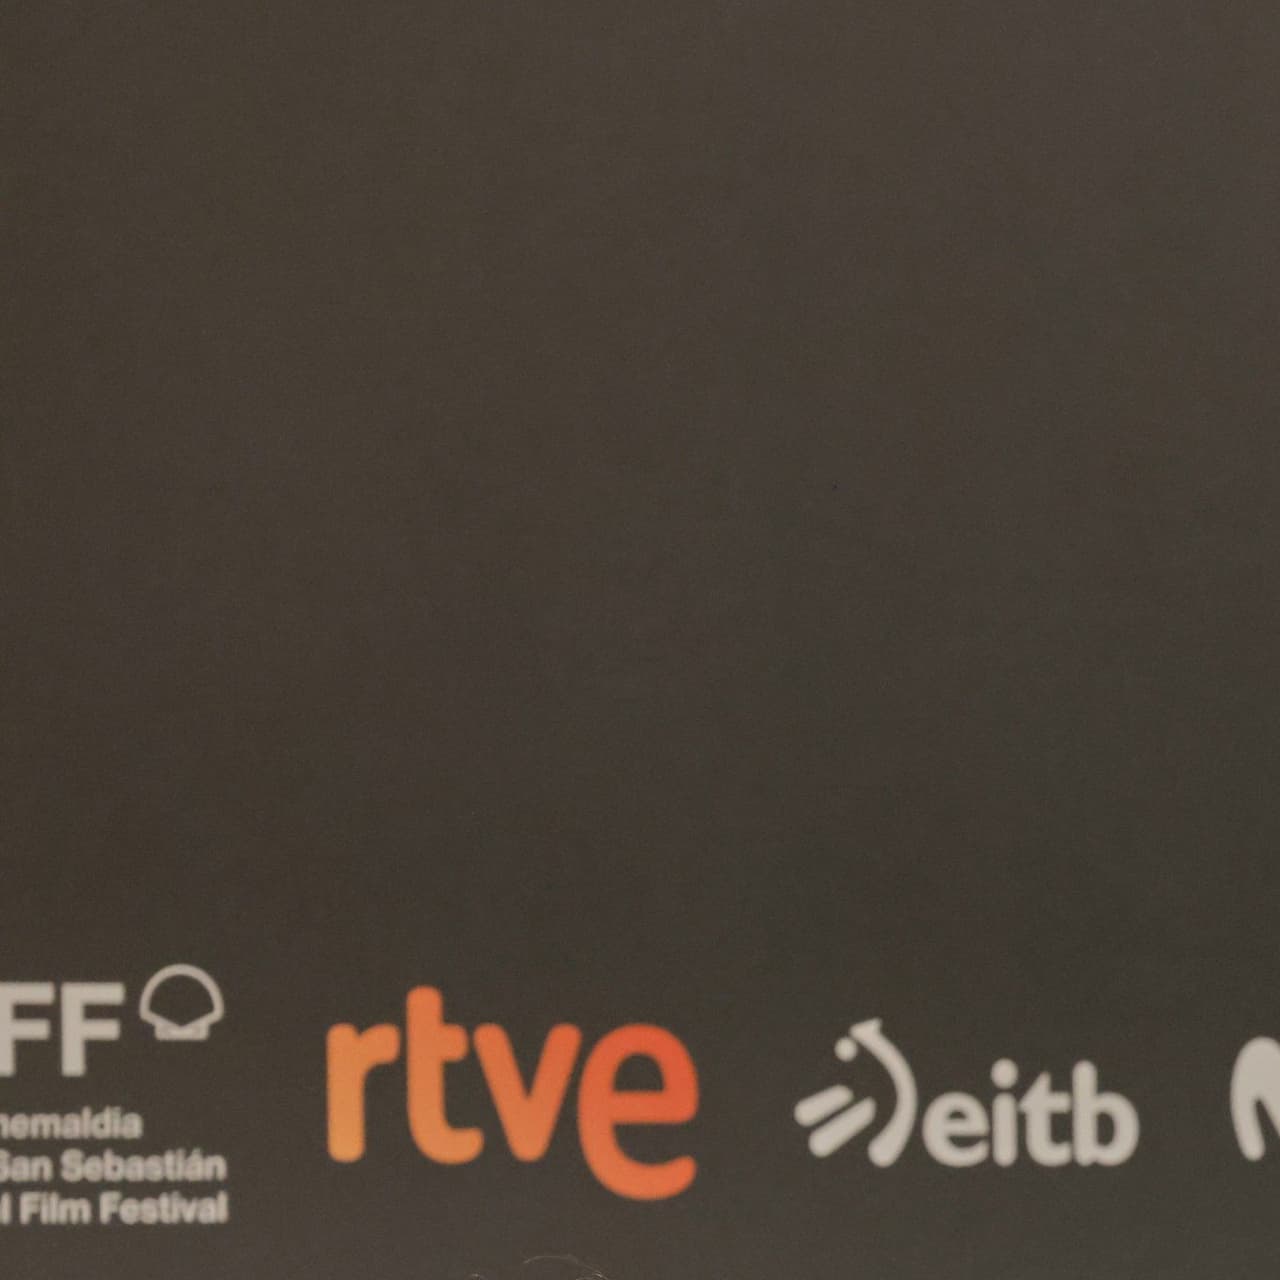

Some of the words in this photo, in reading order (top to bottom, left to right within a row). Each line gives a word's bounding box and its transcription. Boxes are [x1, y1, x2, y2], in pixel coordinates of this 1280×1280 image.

[327, 985, 698, 1201] rtve
[922, 1058, 1140, 1168] eitb
[61, 1148, 228, 1182] Sebastián
[20, 1190, 92, 1224] Film
[100, 1190, 229, 1224] Festival
